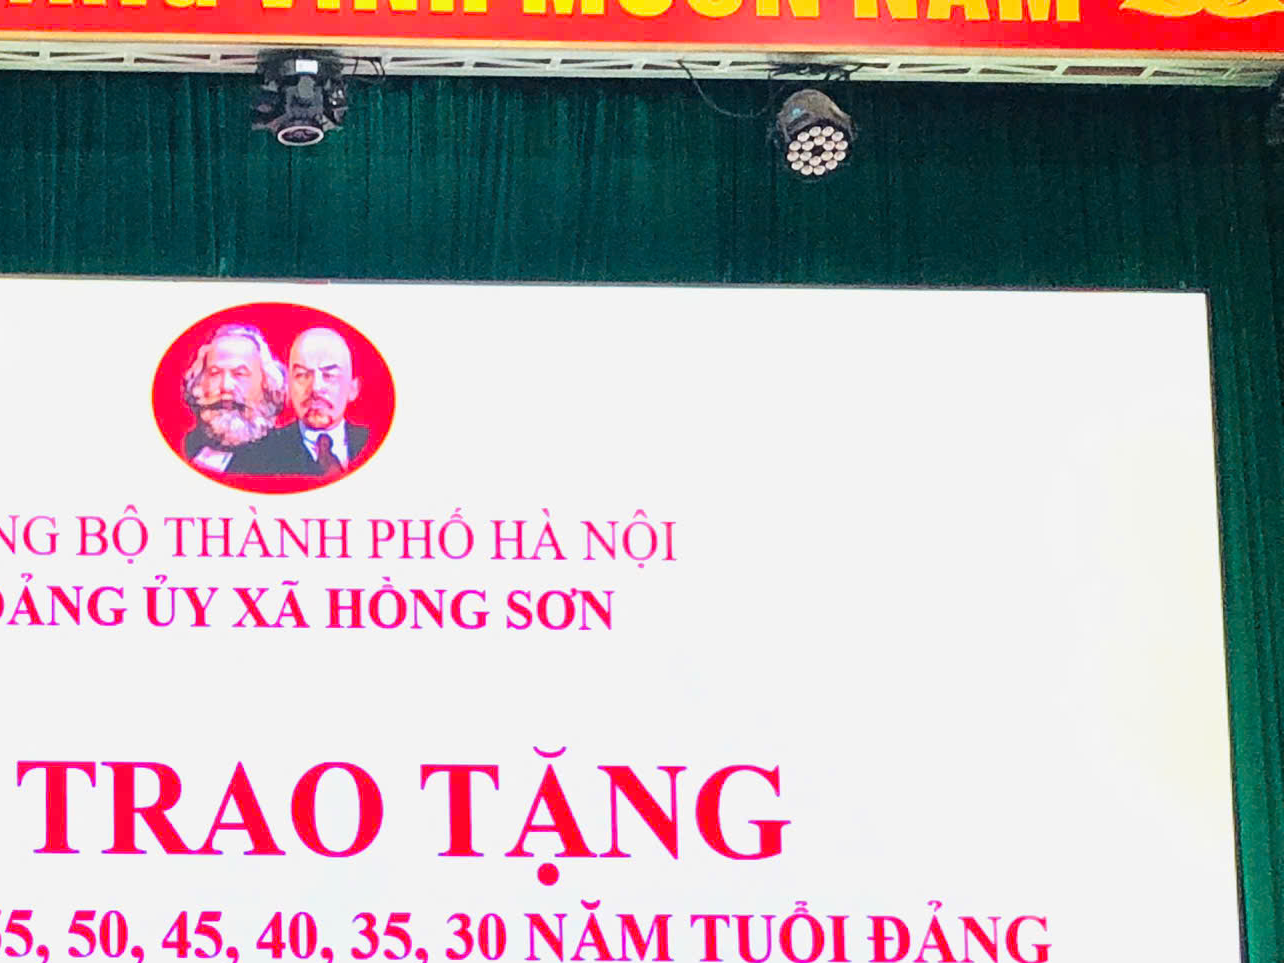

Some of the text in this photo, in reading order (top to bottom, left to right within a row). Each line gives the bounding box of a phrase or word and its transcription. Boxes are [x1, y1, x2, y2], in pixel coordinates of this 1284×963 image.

[76, 504, 148, 565] BỘ
[164, 506, 352, 559] THÀNH
[367, 507, 474, 560] PHỐ
[490, 508, 568, 561] HÀ
[581, 509, 677, 569] NỘI
[143, 574, 219, 628] ỦY
[232, 580, 311, 628] XÃ
[325, 576, 490, 630] HỒNG
[506, 586, 615, 631] SƠN
[15, 760, 384, 858] TRAO
[420, 746, 792, 886] TẶNG
[445, 912, 507, 961] 30
[524, 899, 674, 962] NĂM
